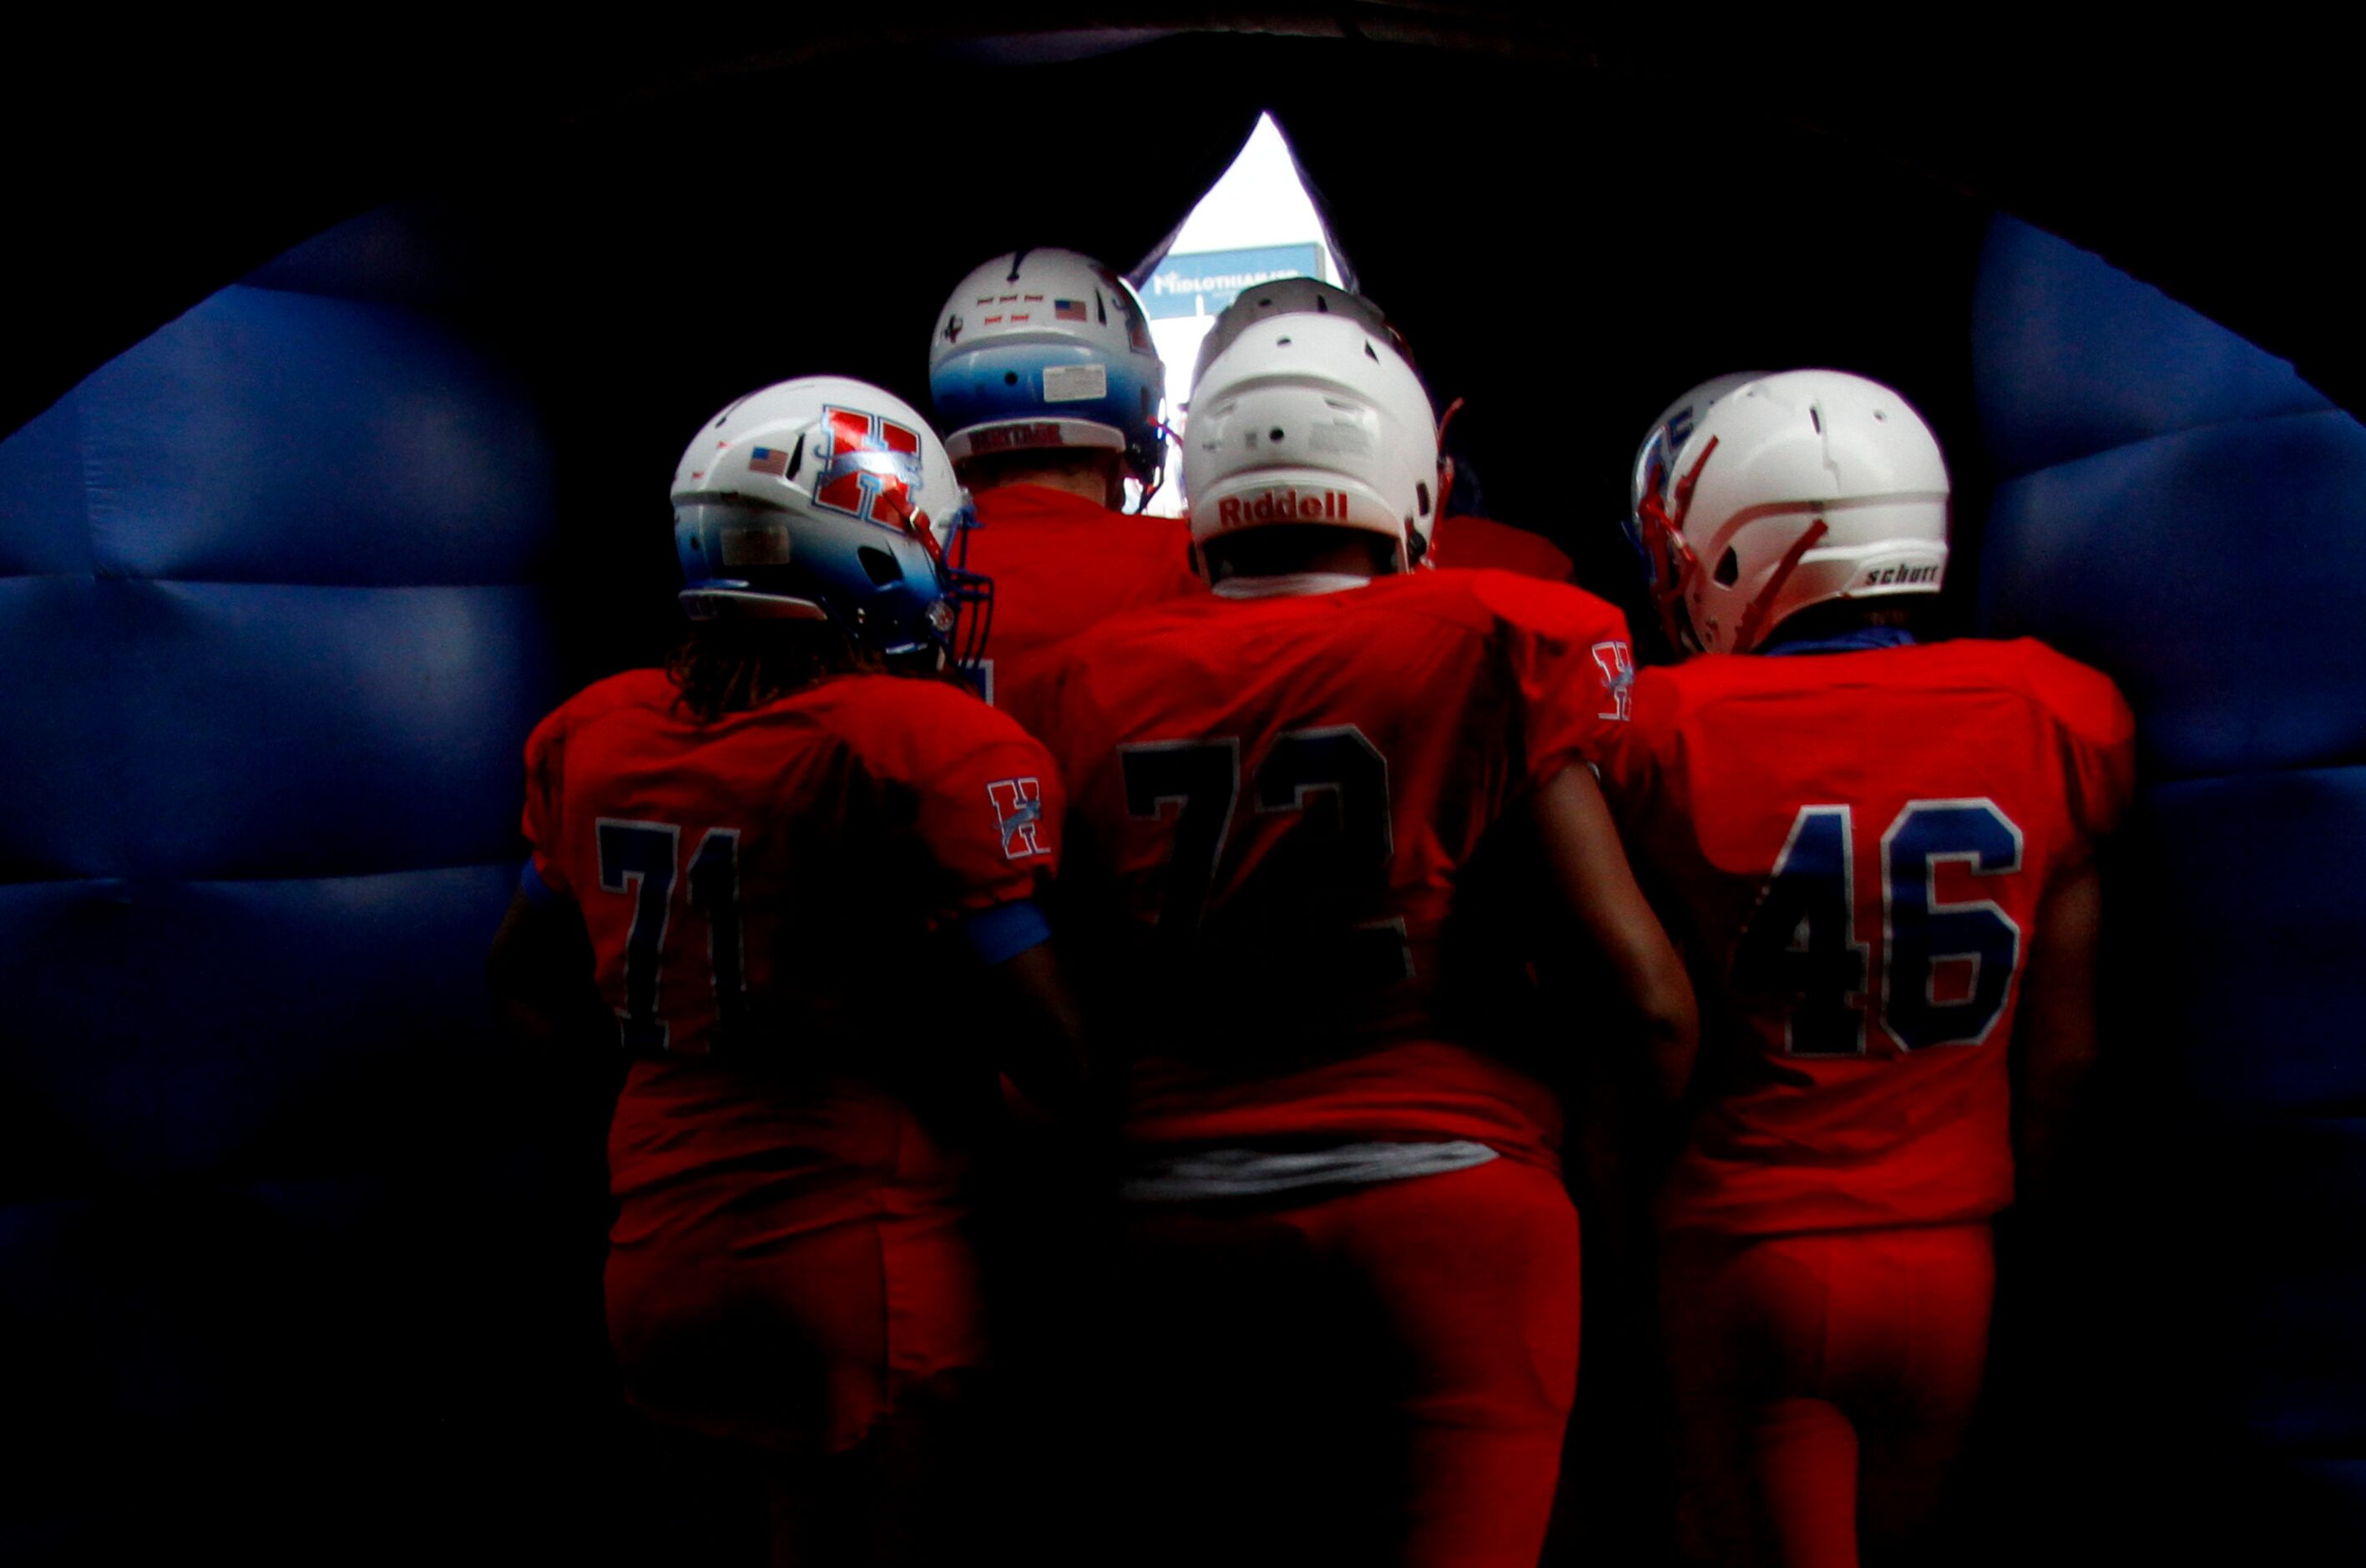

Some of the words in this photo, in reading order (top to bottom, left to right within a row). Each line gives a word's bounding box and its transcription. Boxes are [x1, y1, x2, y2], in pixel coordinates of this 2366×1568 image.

[1219, 488, 1348, 526] Riddell
[594, 816, 754, 1057] 71
[1115, 722, 1417, 981] 72
[1728, 796, 2026, 1059] 46
